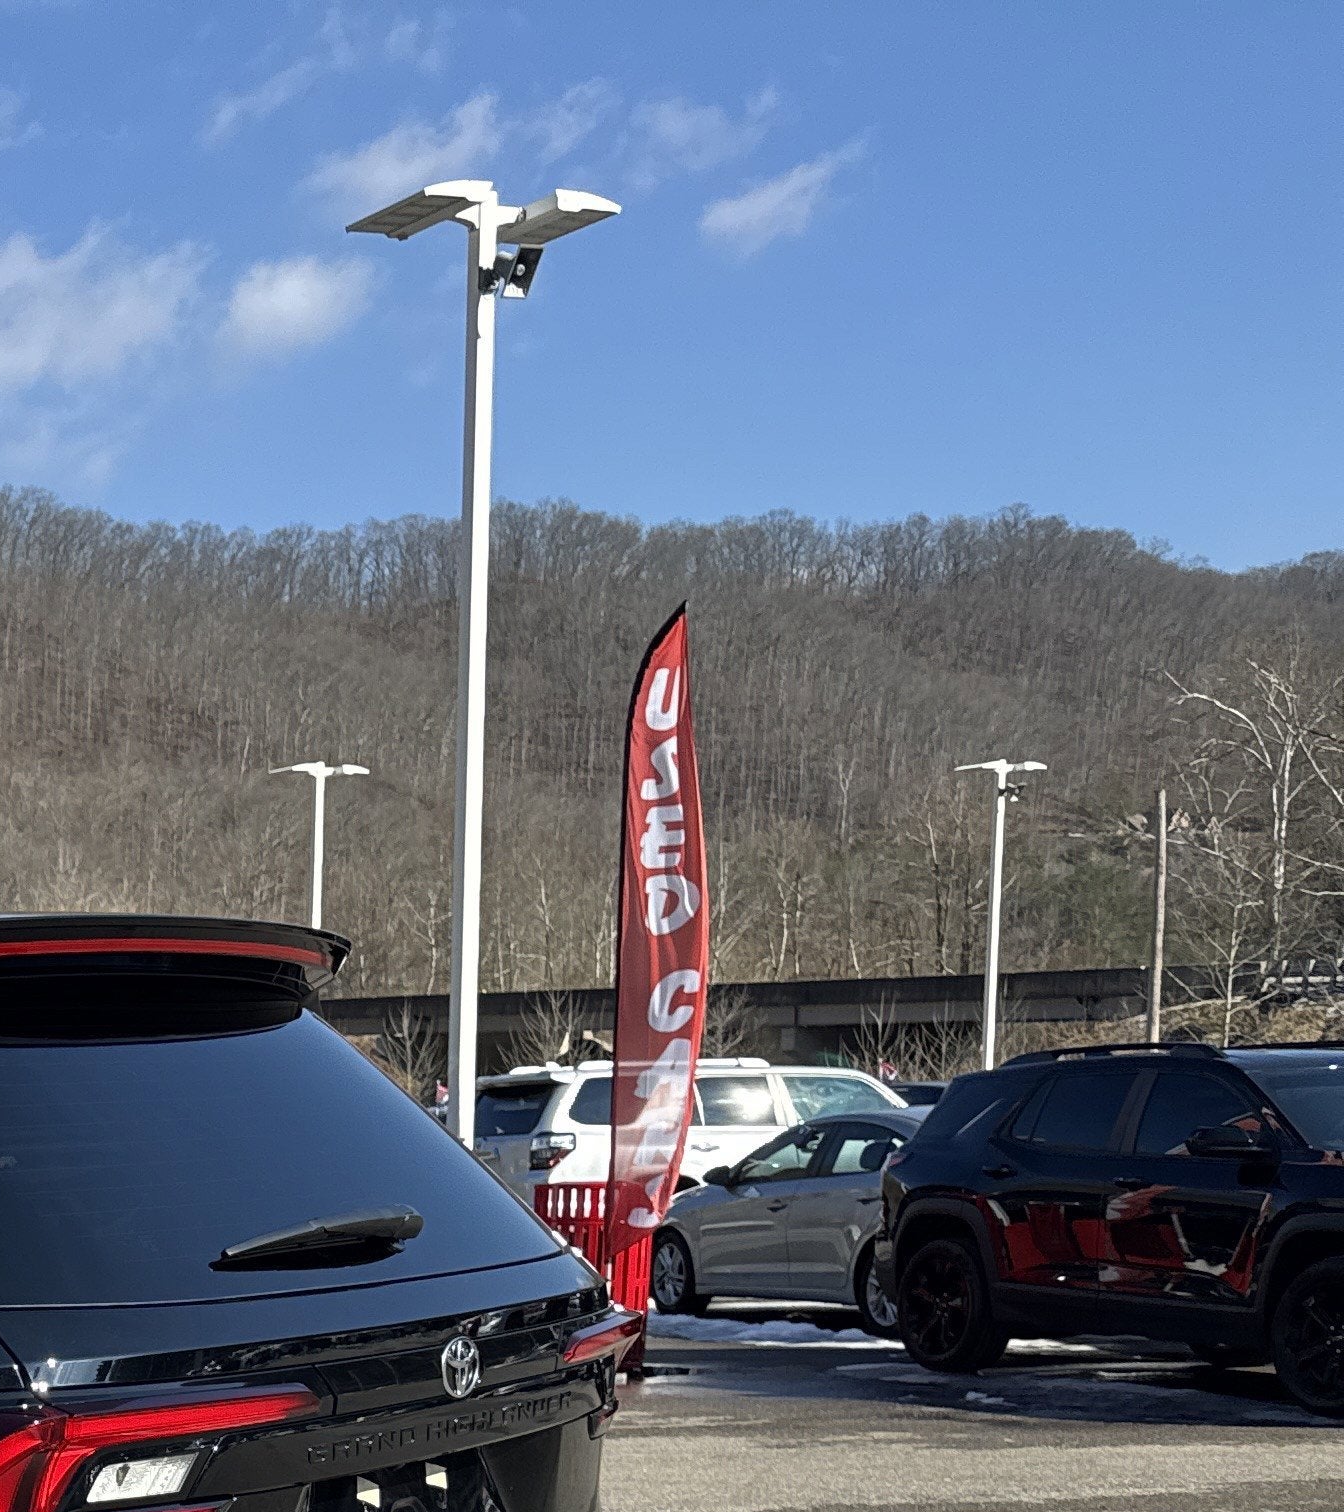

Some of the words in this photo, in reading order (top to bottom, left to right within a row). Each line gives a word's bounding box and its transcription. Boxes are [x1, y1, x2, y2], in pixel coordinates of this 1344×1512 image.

[638, 666, 701, 937] USED
[306, 1427, 416, 1465] GRAND
[426, 1391, 572, 1442] HIGHLANDER
